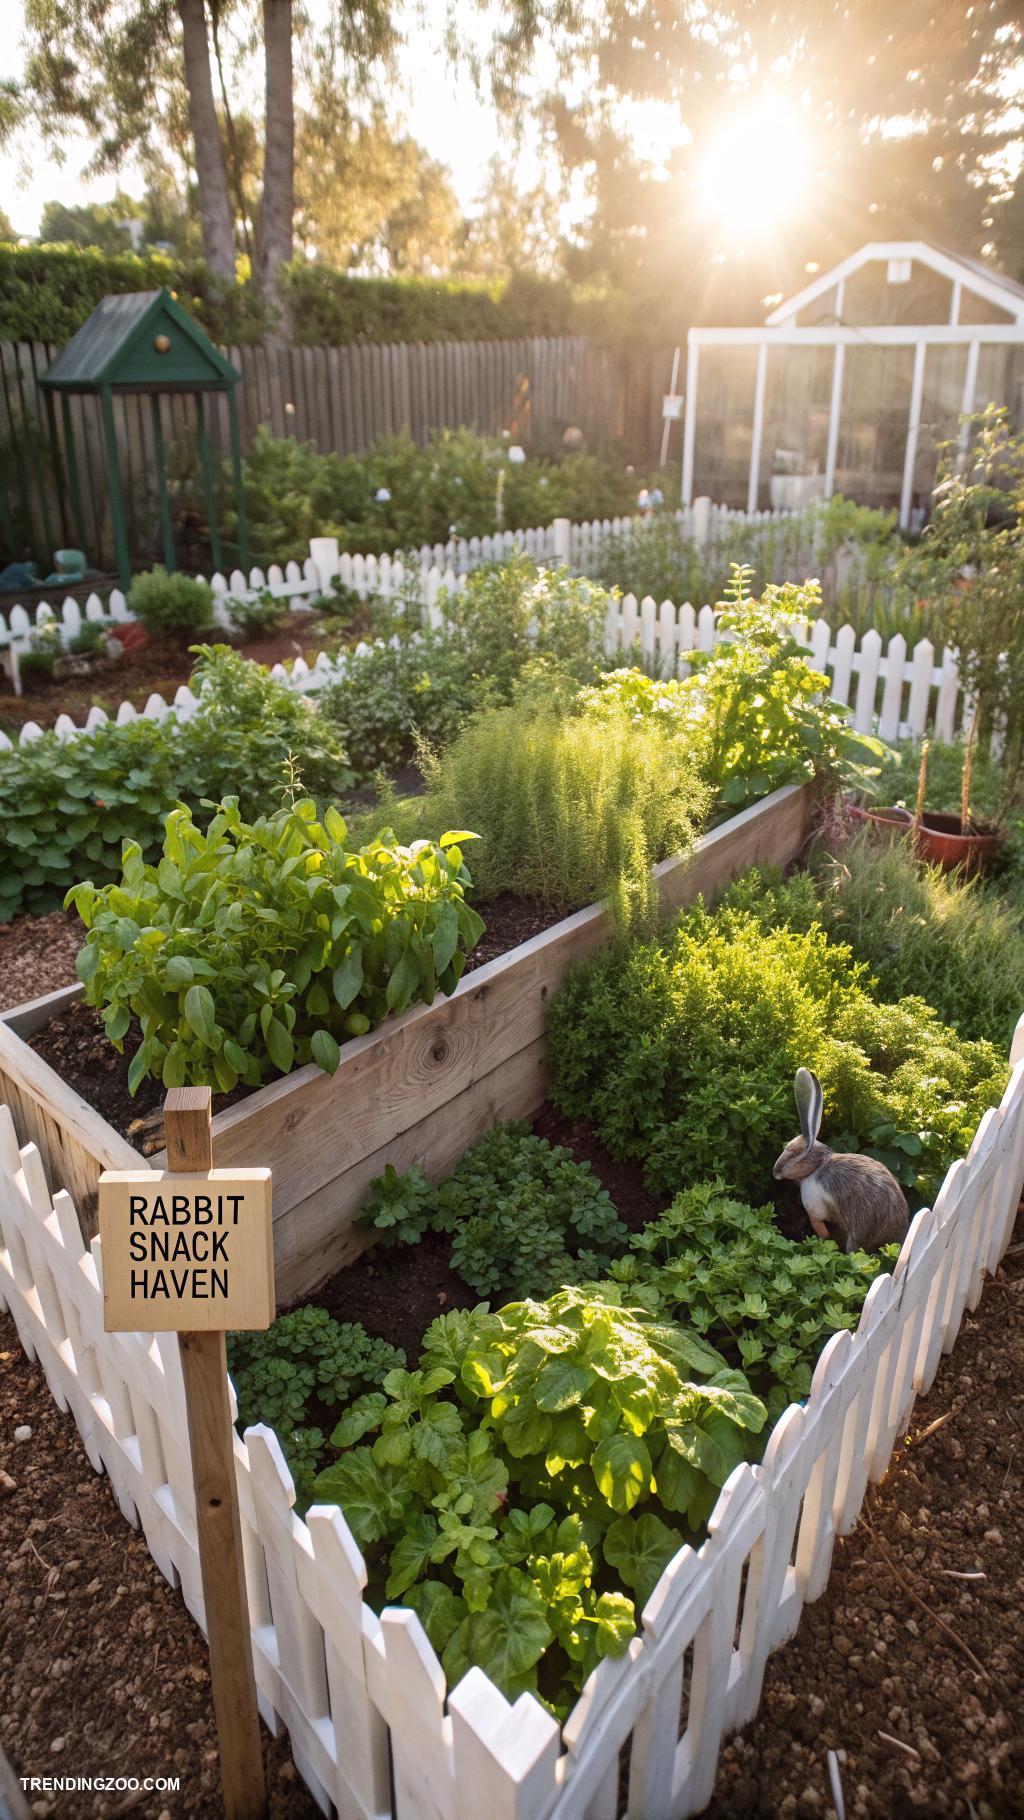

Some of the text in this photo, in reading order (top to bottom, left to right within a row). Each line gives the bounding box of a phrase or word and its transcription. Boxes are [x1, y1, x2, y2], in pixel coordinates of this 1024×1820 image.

[129, 1195, 245, 1226] RABBIT
[129, 1231, 230, 1262] SNACK
[130, 1269, 229, 1299] HAVEN
